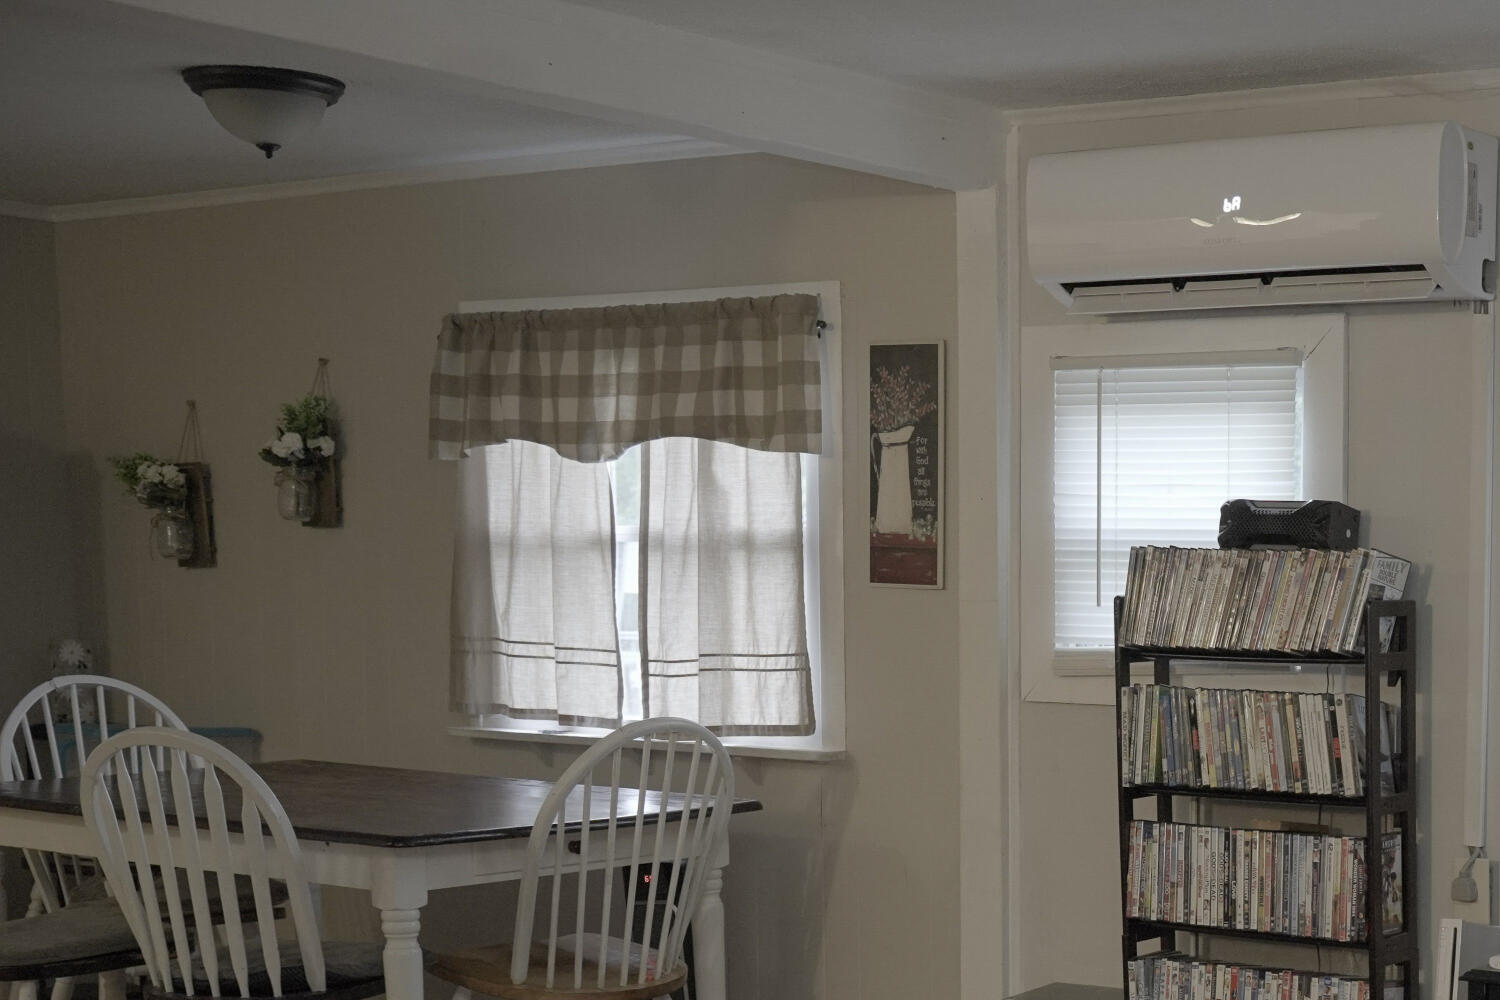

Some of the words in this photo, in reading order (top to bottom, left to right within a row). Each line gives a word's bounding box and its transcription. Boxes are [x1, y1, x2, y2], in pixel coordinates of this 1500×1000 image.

[916, 435, 928, 445] For
[915, 455, 929, 465] God
[912, 477, 931, 488] things
[1376, 560, 1409, 574] FAMILY
